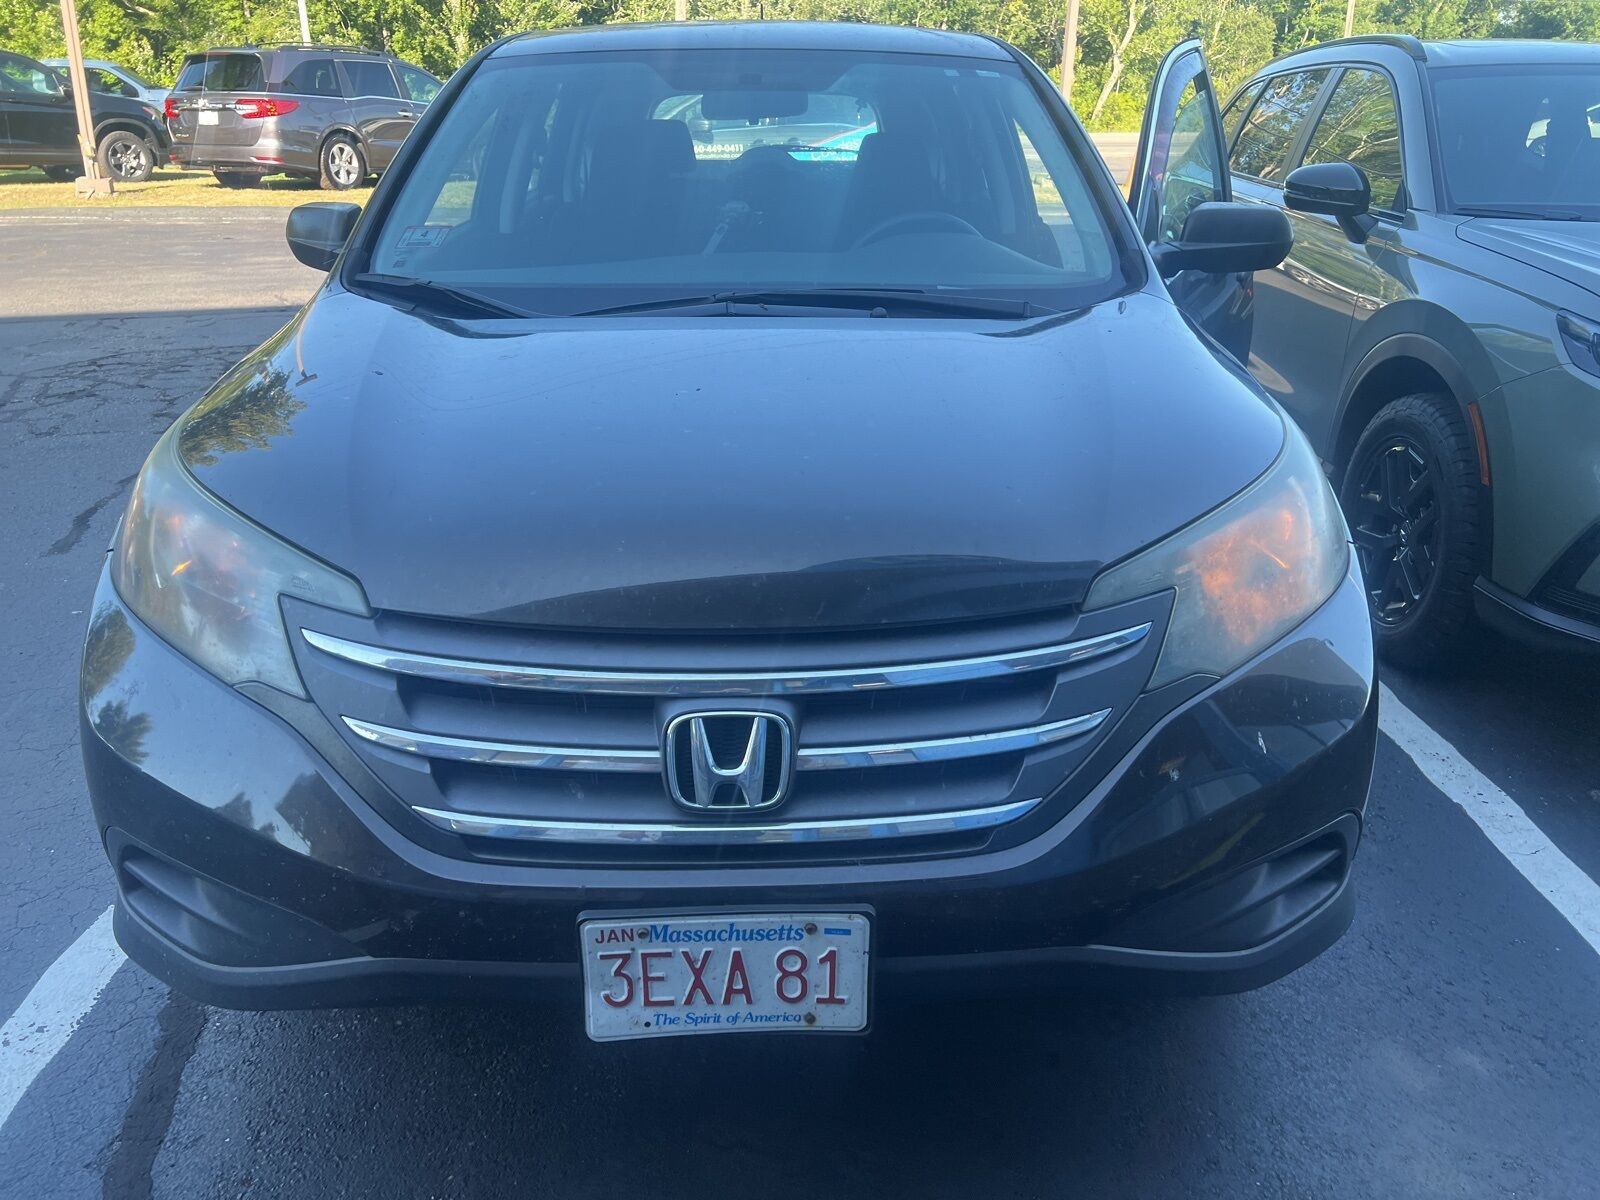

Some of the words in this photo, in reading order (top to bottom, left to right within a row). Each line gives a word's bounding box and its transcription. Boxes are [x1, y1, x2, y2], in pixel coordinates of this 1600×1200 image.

[595, 928, 634, 944] JAN
[648, 922, 805, 943] Massachusetts
[598, 947, 753, 1008] 3EXA
[775, 946, 848, 1005] 81
[653, 1013, 681, 1026] The
[684, 1012, 721, 1026] Spirit
[727, 1012, 741, 1026] of
[743, 1011, 802, 1023] America
